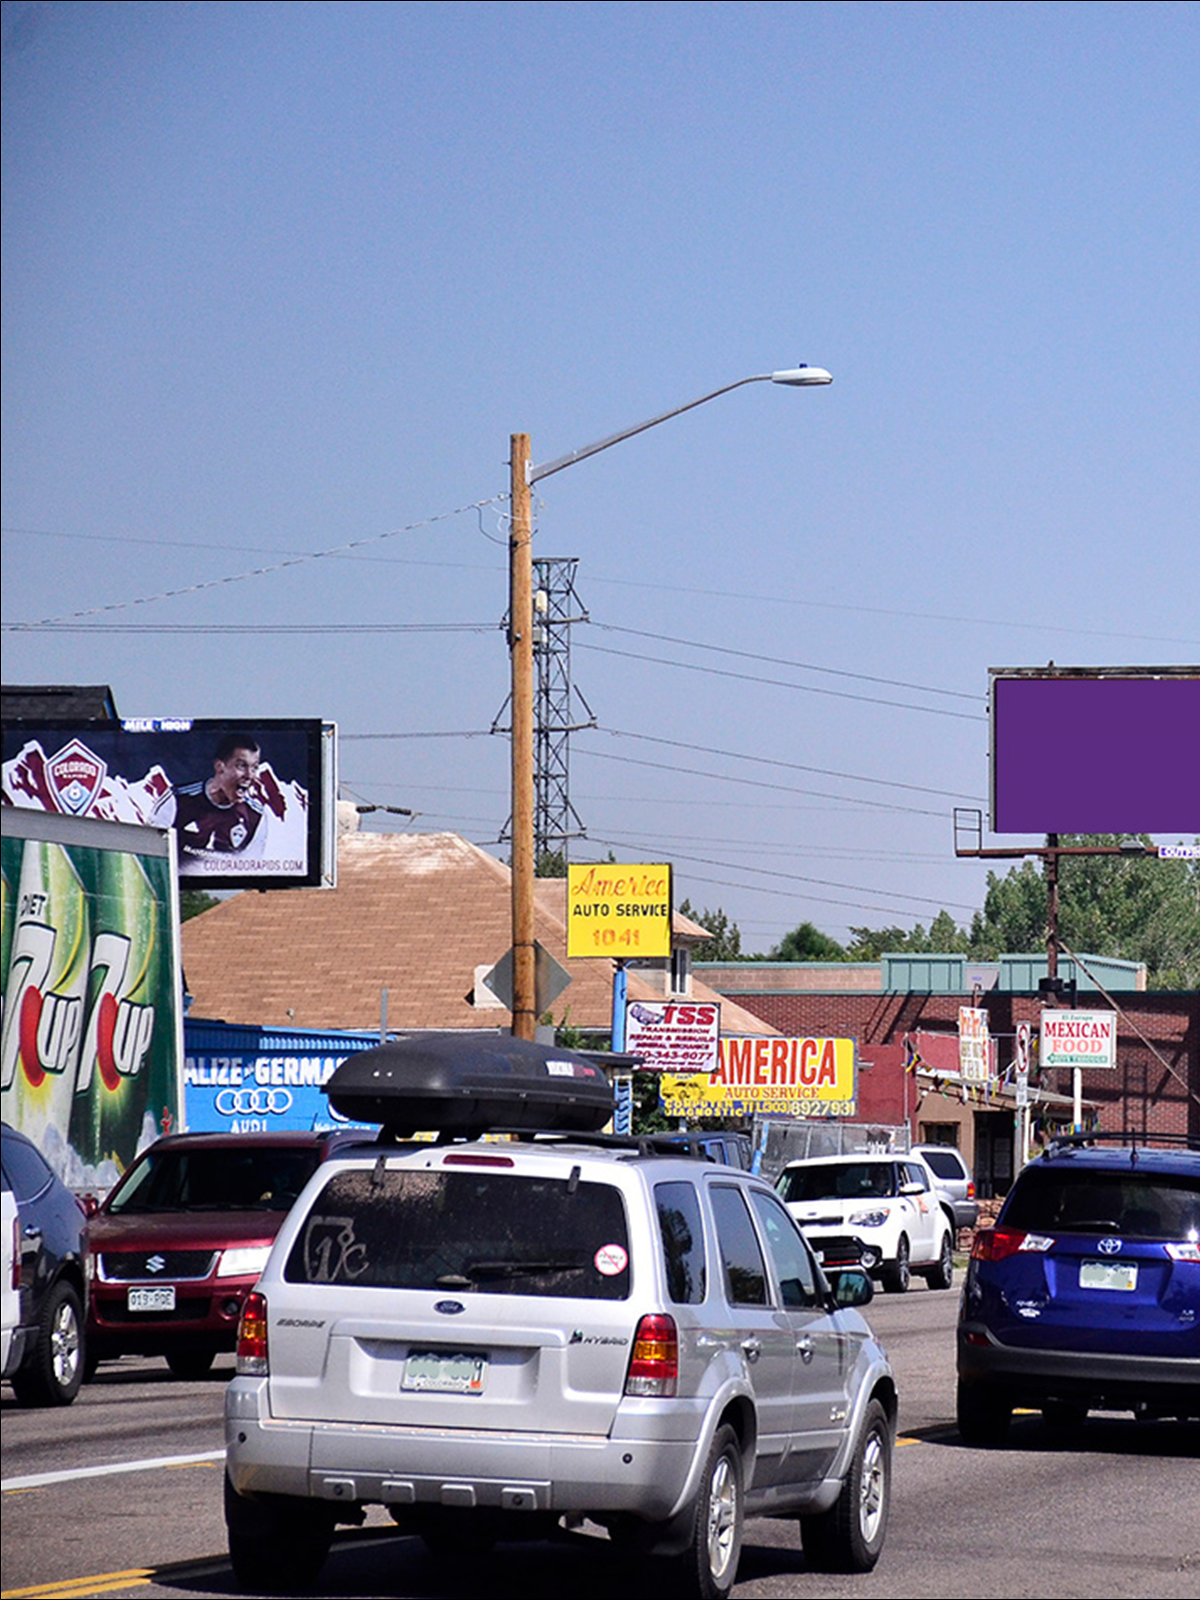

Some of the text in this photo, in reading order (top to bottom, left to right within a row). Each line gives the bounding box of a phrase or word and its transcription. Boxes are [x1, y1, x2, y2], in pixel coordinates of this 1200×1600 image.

[54, 761, 96, 777] COLORADO
[203, 860, 303, 872] COLORADORAPIDS.COM
[571, 867, 667, 897] America
[573, 903, 668, 917] AUTO SERVICE
[592, 928, 640, 946] 1041
[662, 1006, 716, 1026] TSS
[640, 1026, 711, 1035] TRANSMISSION
[1045, 1022, 1110, 1038] MEXICAN
[629, 1033, 663, 1041] REPAIR
[675, 1034, 716, 1043] REBUILD
[1052, 1039, 1103, 1053] FOOD
[709, 1039, 837, 1086] AMERICA
[724, 1087, 820, 1099] AUTO SERVICE
[664, 1100, 733, 1109] COMPUTER
[664, 1107, 744, 1117] DIAGNOSTIC
[230, 1119, 268, 1133] AUDI
[584, 1336, 628, 1346] HYBRID
